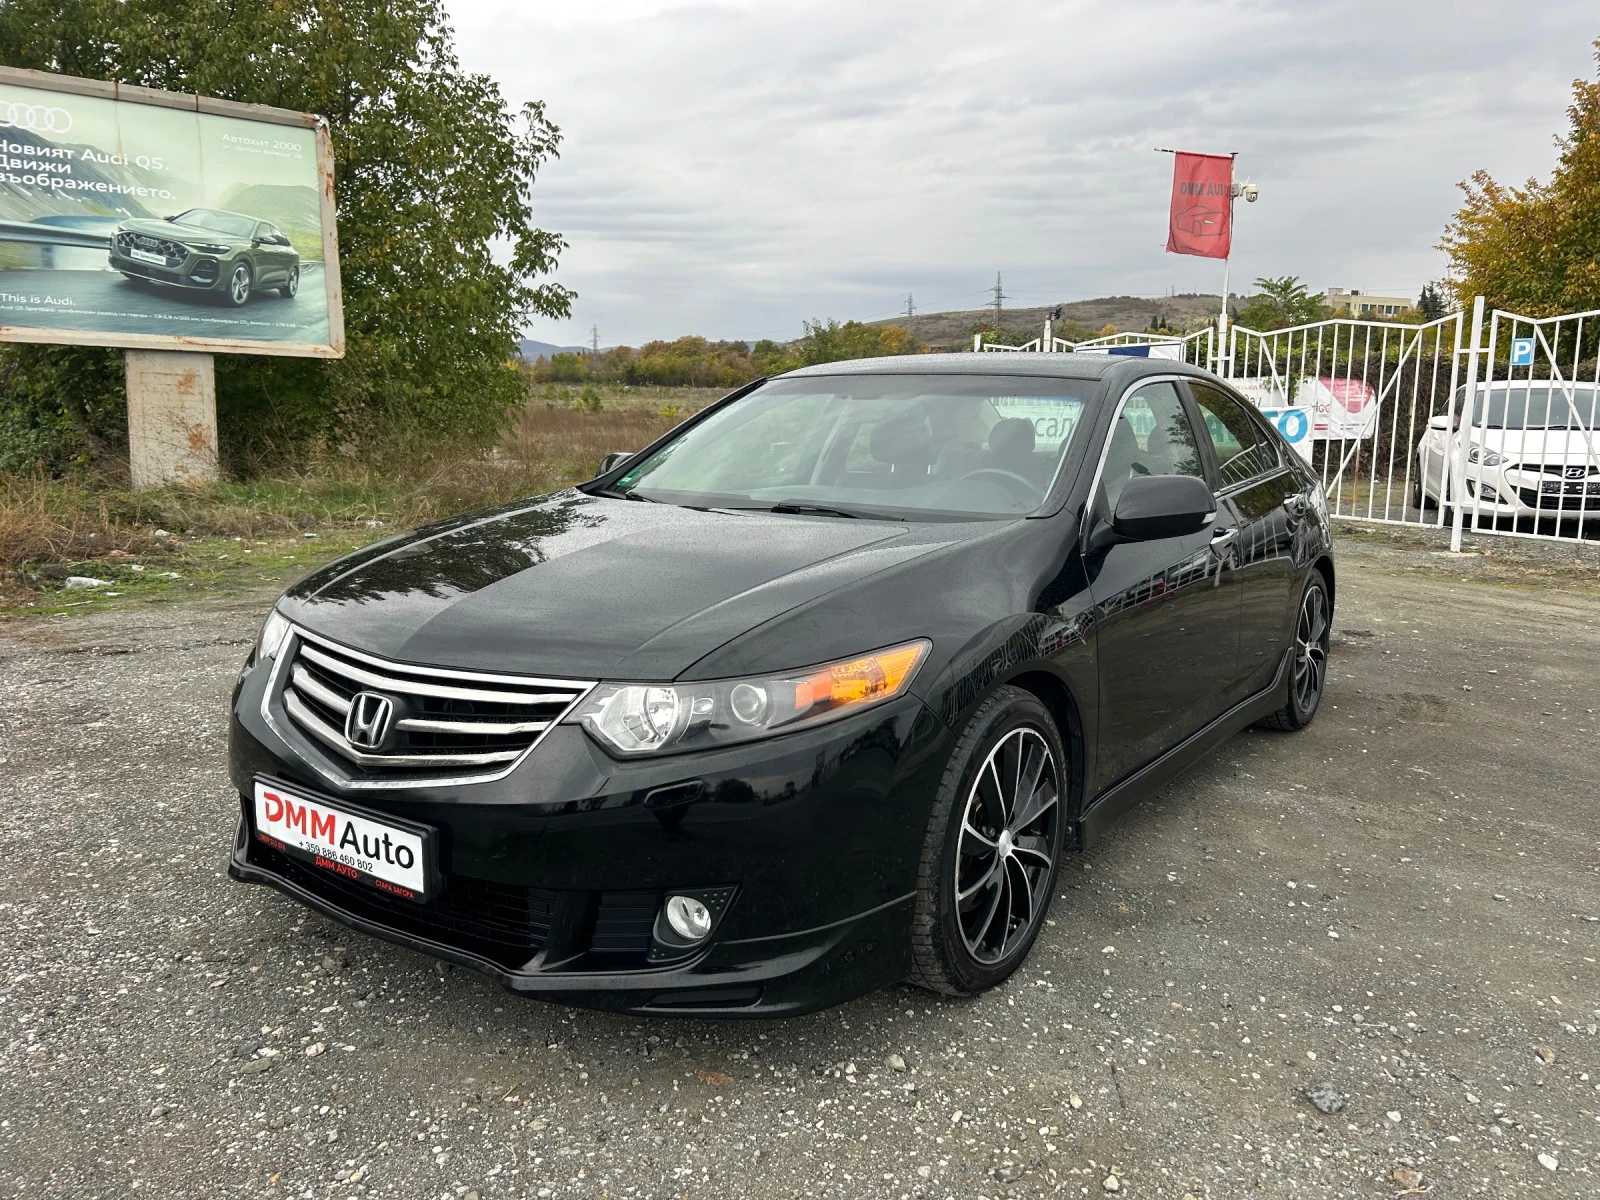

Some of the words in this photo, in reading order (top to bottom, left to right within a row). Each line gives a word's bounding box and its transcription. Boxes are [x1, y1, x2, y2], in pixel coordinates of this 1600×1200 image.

[222, 133, 270, 147] Автохит
[272, 140, 302, 152] 2000
[81, 148, 129, 166] Audi
[135, 154, 170, 171] Q5.
[0, 292, 27, 303] This
[30, 293, 41, 304] is
[43, 295, 76, 306] Audi.
[1513, 341, 1531, 363] P
[305, 841, 320, 855] 359
[339, 853, 355, 866] 460
[357, 858, 373, 873] 802
[337, 863, 358, 879] АУТО
